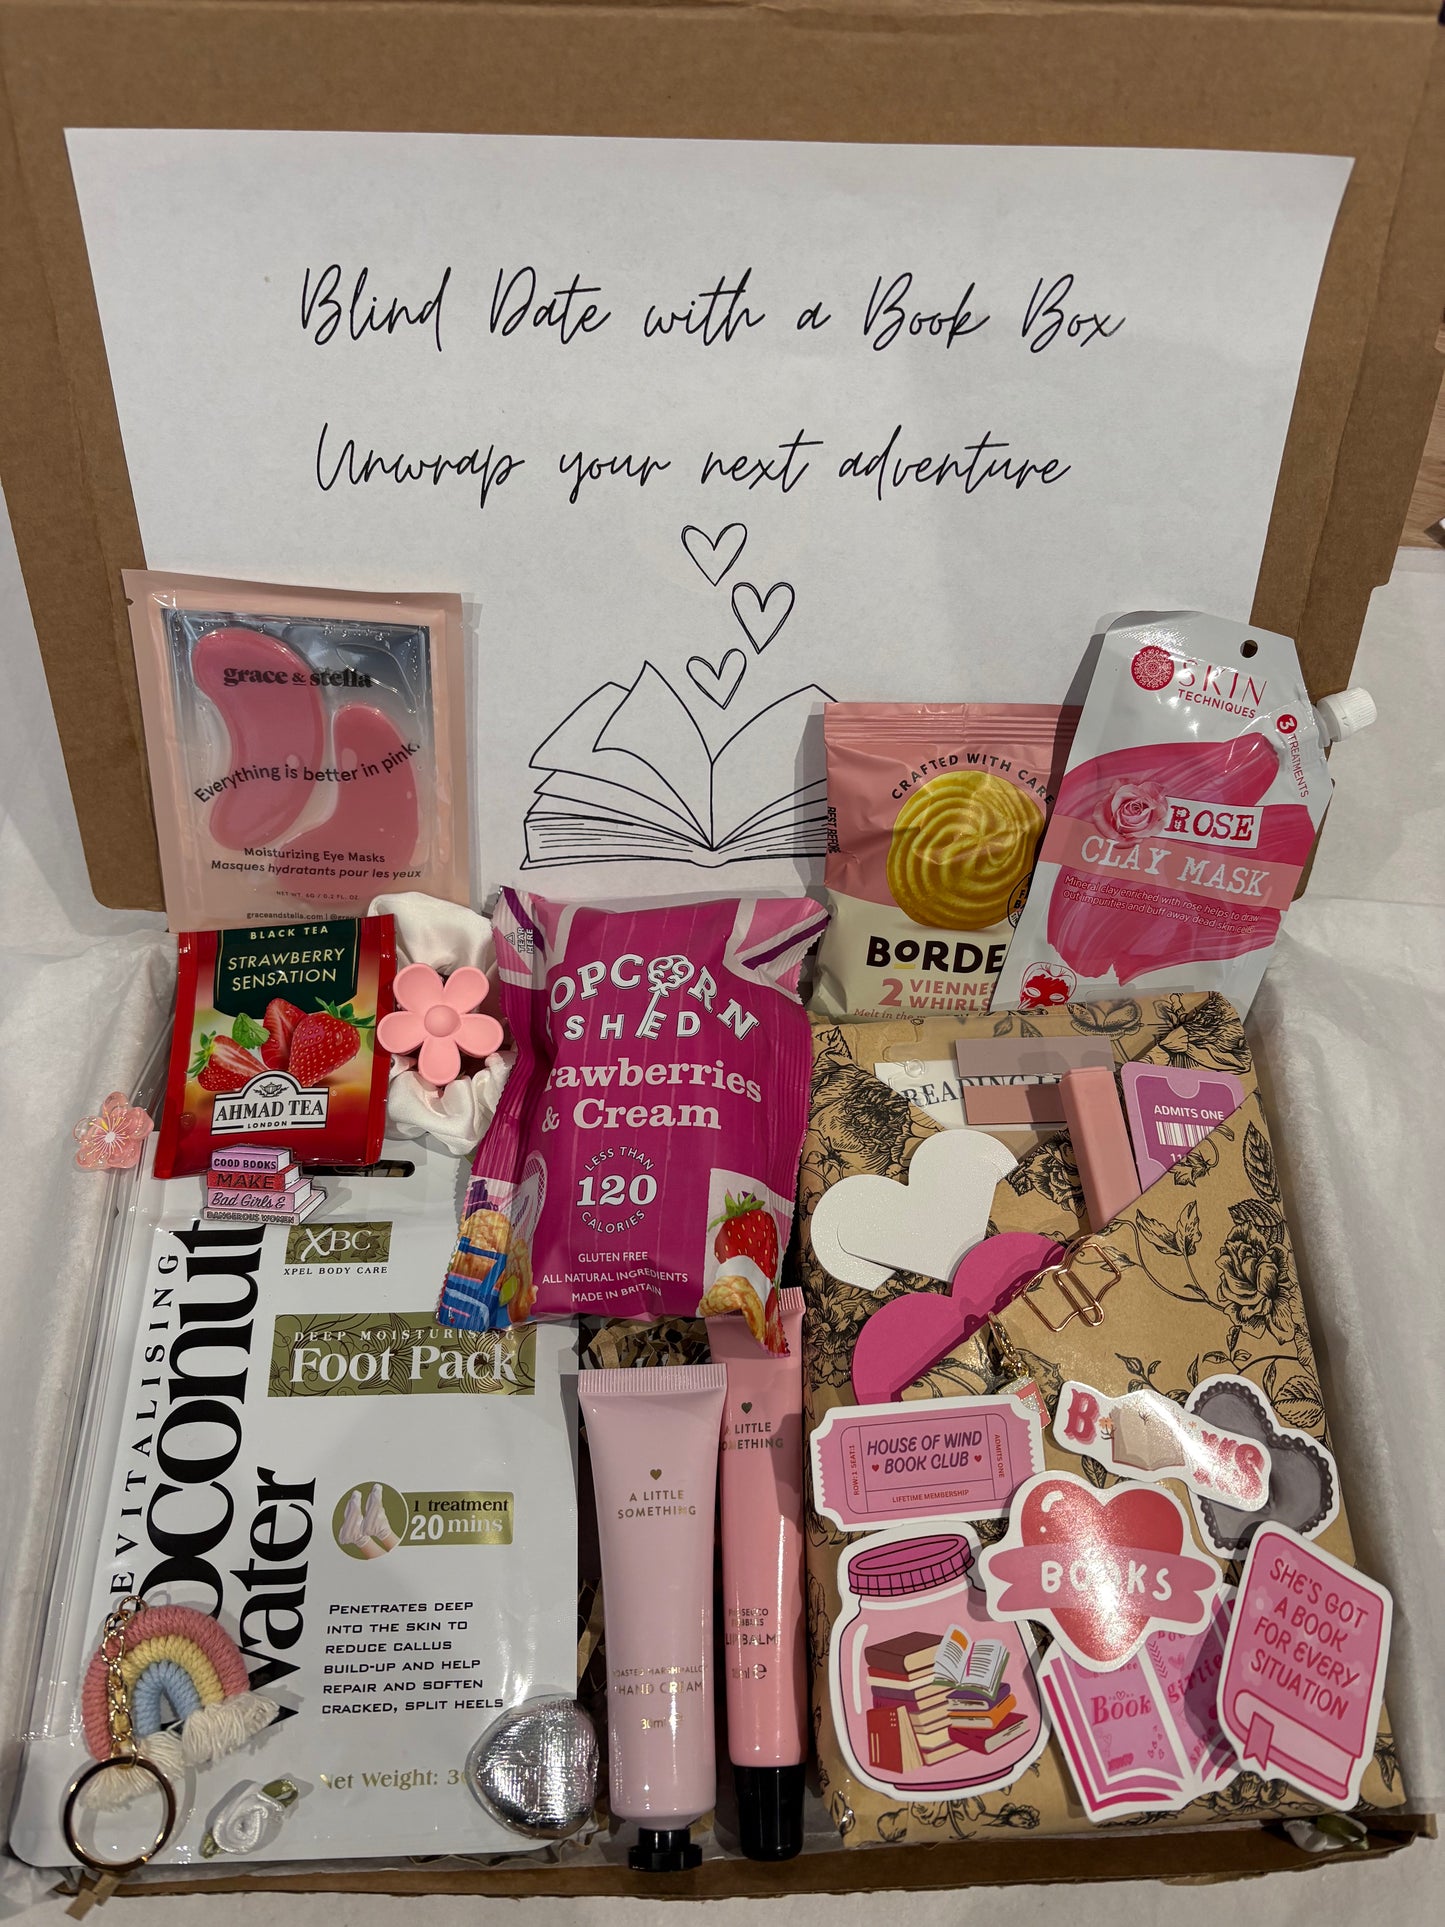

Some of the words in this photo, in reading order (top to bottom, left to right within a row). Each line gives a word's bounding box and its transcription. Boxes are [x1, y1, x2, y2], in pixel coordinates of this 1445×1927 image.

[302, 264, 452, 352] Blind
[490, 266, 611, 345] Date
[644, 267, 766, 346] with
[796, 301, 832, 331] a
[863, 272, 990, 351] Book
[1021, 273, 1127, 353] Box
[316, 422, 526, 509] Unwrap
[559, 451, 671, 504] your
[700, 428, 824, 493] next
[838, 424, 1072, 500] adventure
[224, 668, 288, 686] grace
[292, 672, 306, 686] &
[309, 666, 372, 688] stella
[1178, 660, 1267, 706] SKIN
[1178, 688, 1256, 718] TECHNIQUES
[1280, 718, 1295, 730] 3
[194, 765, 281, 803] Everything
[285, 764, 298, 779] is
[303, 767, 357, 782] better
[362, 763, 379, 777] in
[380, 742, 421, 773] pink.
[1288, 733, 1309, 798] TREATMENTS
[892, 754, 958, 799] CRAFTED
[967, 753, 1011, 772] WITH
[1018, 770, 1054, 804] CARE
[1164, 805, 1254, 841] ROSE
[244, 848, 319, 862] Moisturizing
[324, 851, 344, 862] Eye
[348, 852, 385, 862] Masks
[1081, 835, 1172, 875] CLAY
[1177, 857, 1270, 896] MASK
[211, 860, 265, 872] Masques
[268, 864, 335, 876] hydratants
[339, 869, 369, 878] pour
[372, 869, 390, 878] les
[392, 870, 421, 880] yeux
[1065, 875, 1099, 891] Mineral
[1100, 884, 1120, 897] clay
[1121, 888, 1159, 902] enriched
[1161, 896, 1180, 906] with
[1183, 901, 1202, 912] rose
[1204, 905, 1229, 918] helps
[1231, 912, 1239, 920] to
[1242, 913, 1260, 922] draw
[1063, 890, 1080, 899] out
[1128, 903, 1145, 912] and
[1147, 906, 1165, 916] buff
[1167, 911, 1189, 922] away
[1192, 916, 1216, 927] dead
[1218, 922, 1235, 932] skin
[250, 927, 296, 940] BLACK
[303, 925, 330, 935] TEA
[227, 948, 345, 971] STRAWBERRY
[232, 968, 337, 992] SENSATION
[545, 954, 759, 1043] OPCORN
[878, 978, 903, 1007] 2
[909, 996, 990, 1011] WHIRLS
[564, 1009, 700, 1040] SHED
[854, 1008, 879, 1019] Melt
[881, 1011, 893, 1019] in
[896, 1011, 913, 1020] the
[544, 1058, 762, 1103] rawberries
[215, 1101, 284, 1121] AHMAD
[288, 1100, 324, 1116] TEA
[541, 1106, 560, 1133] &
[573, 1098, 721, 1130] Cream
[1154, 1105, 1198, 1118] ADMITS
[1201, 1110, 1225, 1121] ONE
[243, 1160, 276, 1169] BOOKS
[585, 1148, 614, 1171] LESS
[620, 1147, 654, 1170] THAN
[217, 1174, 275, 1189] MAKE
[577, 1175, 657, 1206] 120
[212, 1192, 239, 1206] Bad
[241, 1193, 273, 1208] Girls
[275, 1196, 286, 1208] &
[207, 1211, 259, 1221] DANGEROUS
[261, 1214, 294, 1224] WOMEN
[582, 1210, 645, 1233] CALORIES
[300, 1226, 373, 1261] XBC
[578, 1253, 619, 1263] GLUTEN
[623, 1251, 648, 1261] FREE
[283, 1268, 312, 1276] XPEL
[357, 1266, 388, 1274] CARE
[542, 1274, 562, 1284] ALL
[565, 1273, 614, 1283] NATURAL
[616, 1268, 688, 1283] INGREDIENTS
[571, 1292, 603, 1302] MADE
[605, 1291, 618, 1299] IN
[621, 1283, 662, 1296] BRITAIN
[294, 1331, 347, 1342] DEEP
[290, 1346, 394, 1382] Foot
[408, 1344, 518, 1380] Pack
[136, 1219, 267, 1625] oconut
[735, 1422, 771, 1434] LITTLE
[103, 1253, 180, 1634] EVITALISING
[867, 1437, 917, 1455] HOUSE
[921, 1435, 940, 1450] OF
[944, 1431, 982, 1449] WIND
[995, 1434, 1003, 1461] ADMITS
[884, 1455, 927, 1474] BOOK
[931, 1451, 969, 1469] CLUB
[997, 1462, 1005, 1478] ONE
[414, 1500, 419, 1512] 1
[428, 1499, 508, 1511] treatment
[630, 1492, 637, 1502] A
[644, 1490, 684, 1500] LITTLE
[892, 1494, 923, 1503] LIFETIME
[924, 1490, 969, 1500] MEMBERSHIP
[618, 1506, 696, 1519] SOMETHING
[410, 1514, 444, 1540] 20
[448, 1515, 503, 1532] mins
[1270, 1558, 1323, 1605] SHE'S
[1325, 1593, 1368, 1628] GOT
[329, 1603, 427, 1614] PENETRATES
[435, 1602, 473, 1611] DEEP
[327, 1624, 362, 1634] INTO
[370, 1623, 399, 1632] THE
[406, 1622, 441, 1631] SKIN
[448, 1621, 468, 1630] TO
[1274, 1597, 1288, 1619] A
[1291, 1605, 1348, 1652] BOOK
[325, 1643, 387, 1654] REDUCE
[394, 1641, 452, 1651] CALLUS
[1254, 1616, 1291, 1654] FOR
[1293, 1642, 1360, 1688] EVERY
[324, 1663, 396, 1674] BUILD-UP
[402, 1661, 434, 1671] AND
[441, 1660, 480, 1669] HELP
[323, 1684, 376, 1694] REPAIR
[383, 1682, 415, 1691] AND
[423, 1680, 483, 1690] SOFTEN
[1251, 1648, 1349, 1720] SITUATION
[322, 1703, 398, 1714] CRACKED,
[405, 1701, 448, 1710] SPLIT
[455, 1699, 503, 1708] HEELS
[1091, 1695, 1151, 1726] Book
[362, 1768, 438, 1791] Weight:
